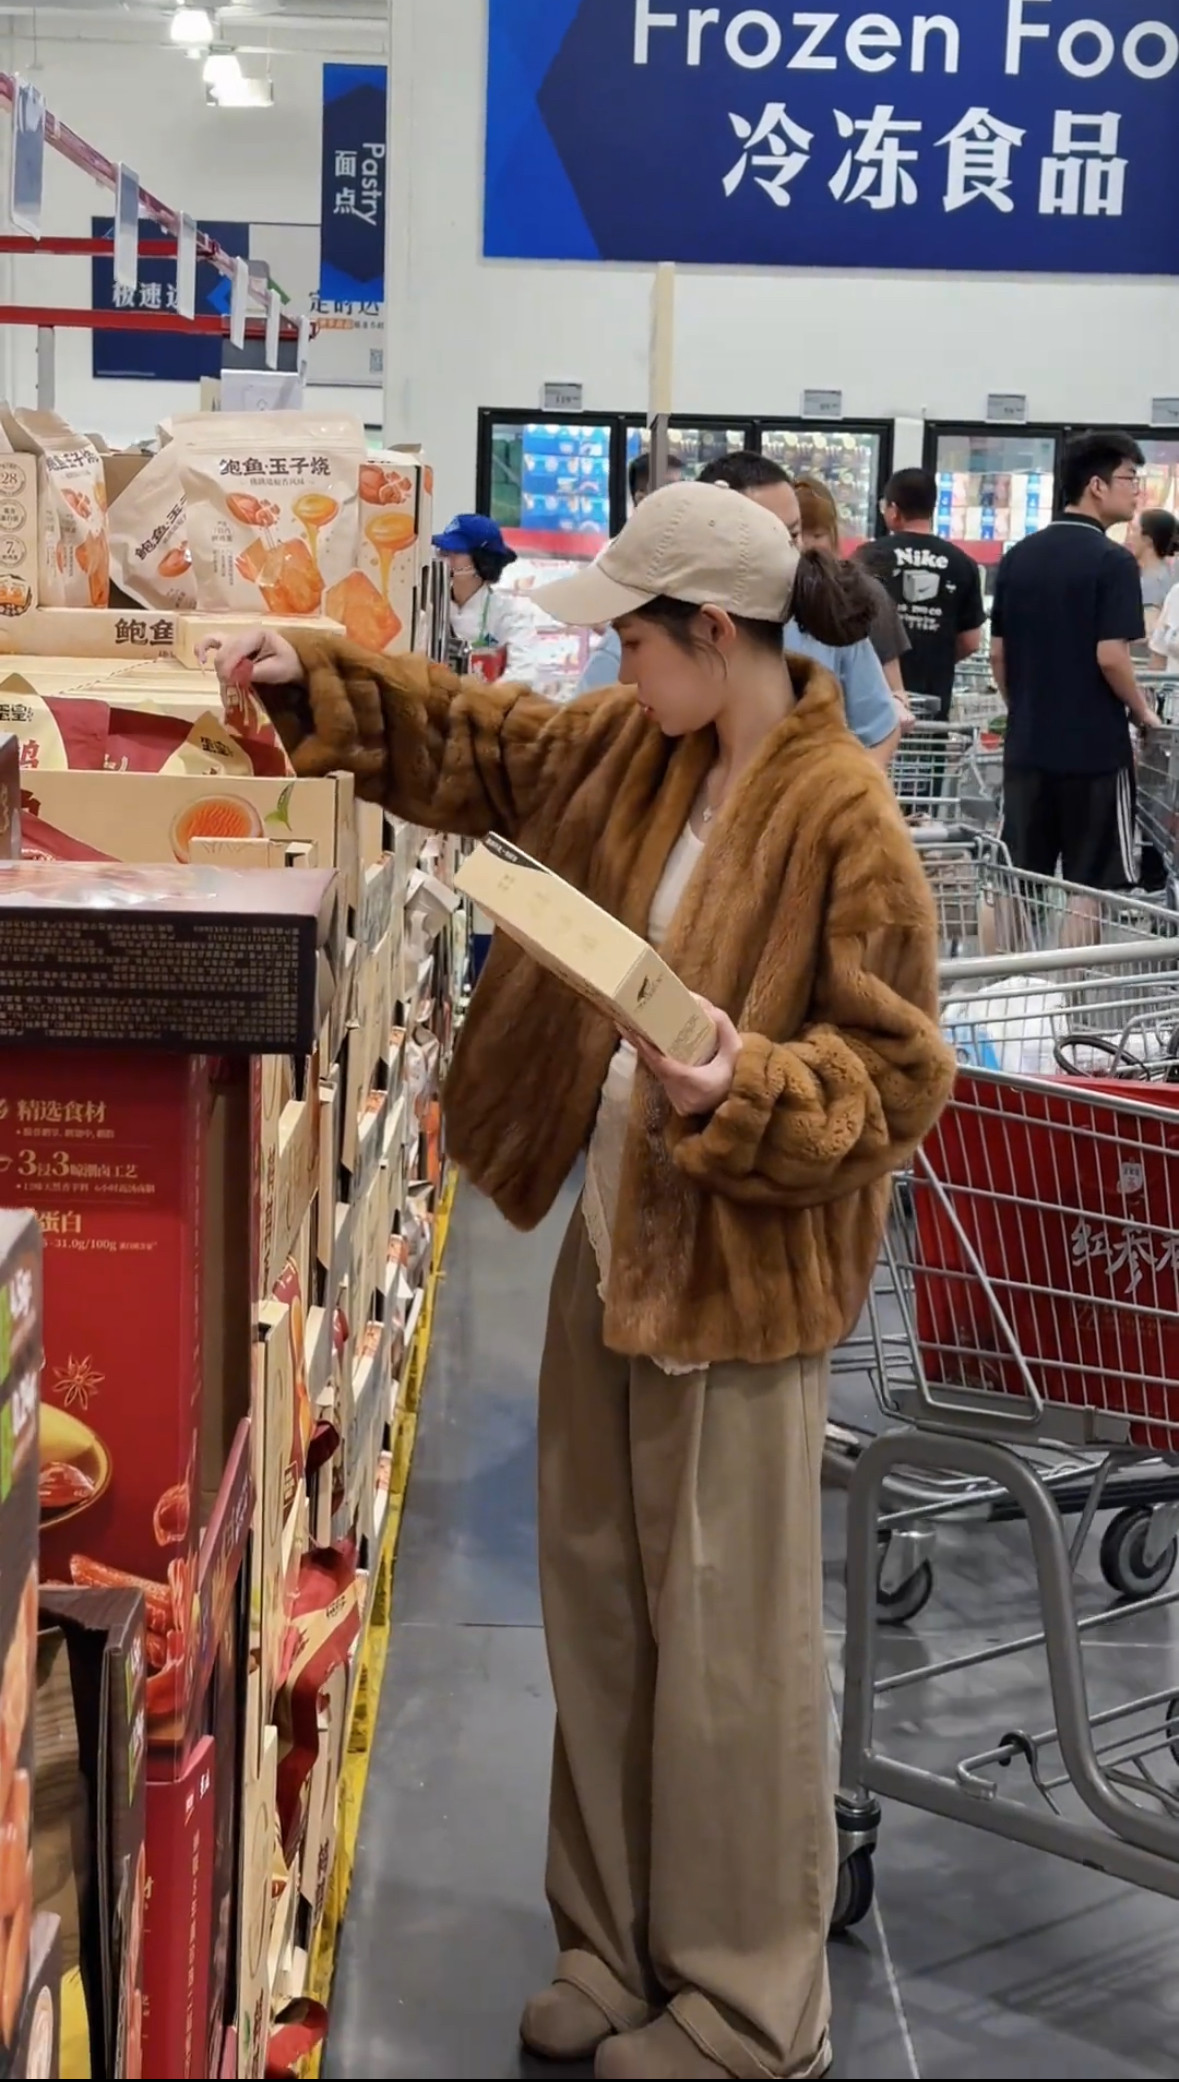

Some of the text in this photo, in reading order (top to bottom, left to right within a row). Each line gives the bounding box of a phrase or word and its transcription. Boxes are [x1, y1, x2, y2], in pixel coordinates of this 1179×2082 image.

[634, 0, 1179, 79] Frozen Foo
[333, 150, 358, 215] 面点
[722, 102, 1129, 217] 冷冻食品
[351, 142, 386, 227] Pastry
[893, 547, 949, 569] Nike
[114, 617, 175, 646] 鲍鱼
[17, 1099, 108, 1124] 精选食材
[34, 1209, 82, 1235] 蛋白
